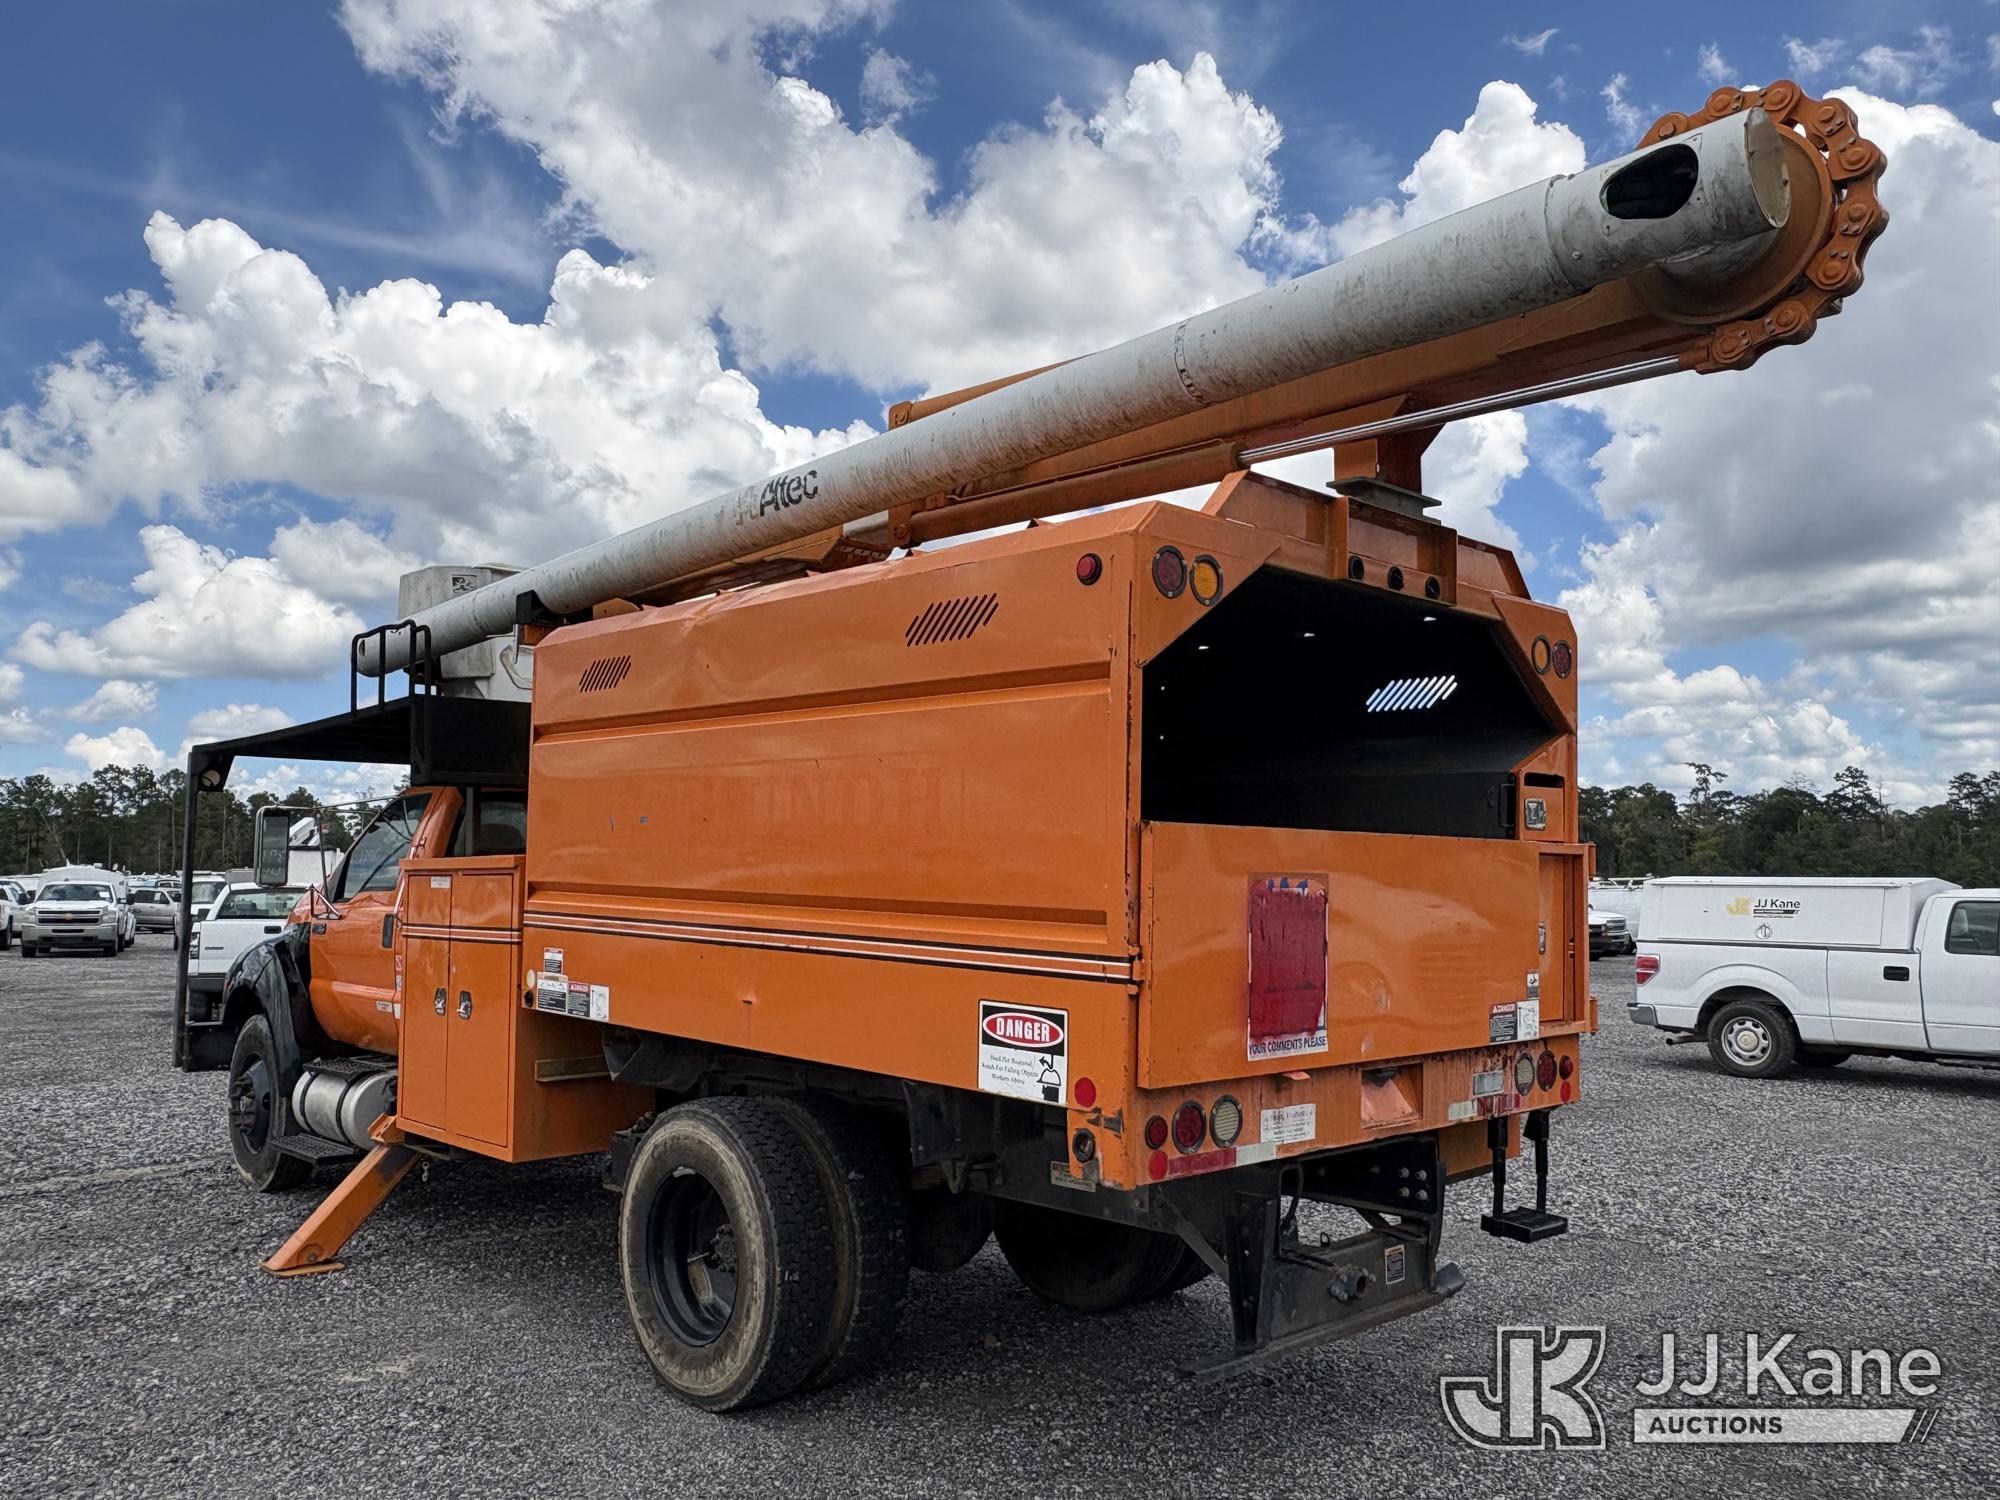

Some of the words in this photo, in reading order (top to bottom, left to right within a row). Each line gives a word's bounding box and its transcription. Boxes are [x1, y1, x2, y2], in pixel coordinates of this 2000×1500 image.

[760, 469, 818, 517] Altec
[1754, 898, 1768, 908] JJ
[1770, 898, 1801, 909] Kane
[996, 1017, 1050, 1043] DANGER
[1249, 1043, 1267, 1056] YOUR
[1267, 1038, 1303, 1052] COMMENTS
[1303, 1035, 1326, 1049] PLEASE
